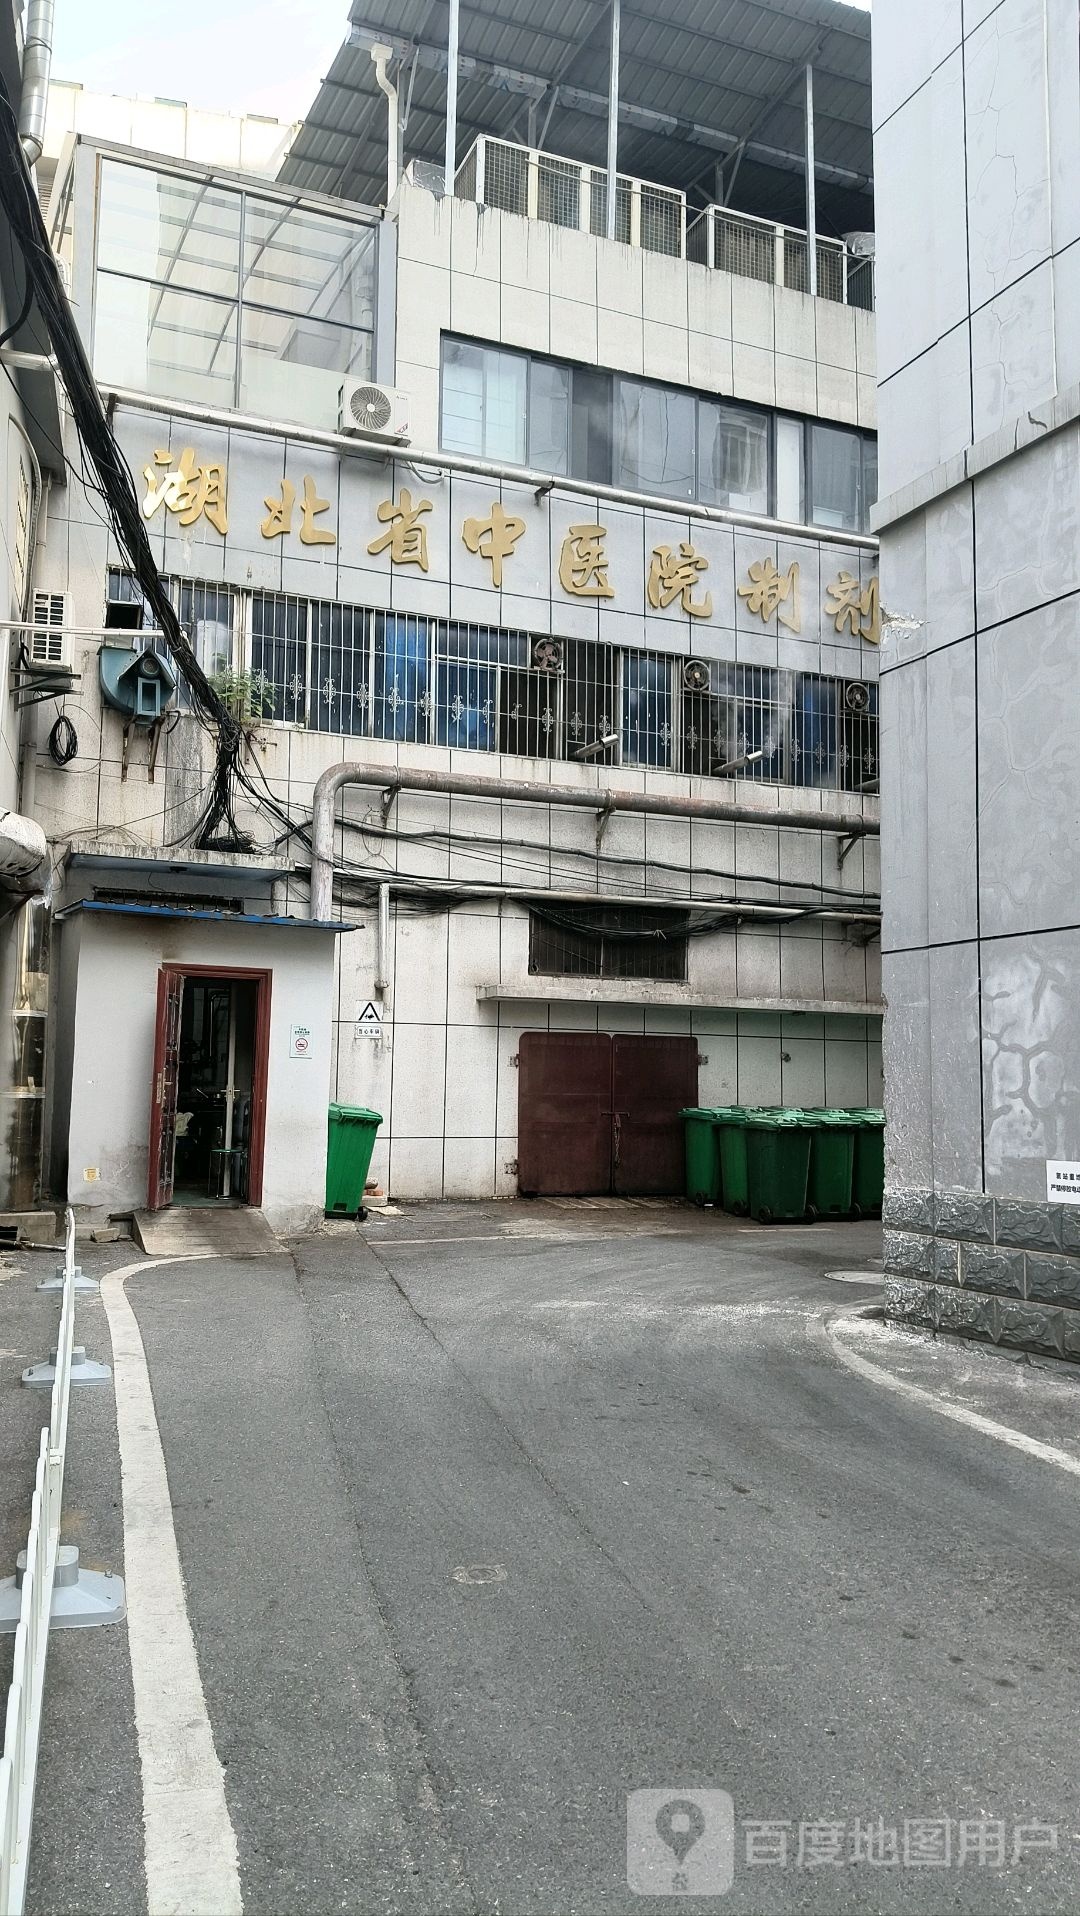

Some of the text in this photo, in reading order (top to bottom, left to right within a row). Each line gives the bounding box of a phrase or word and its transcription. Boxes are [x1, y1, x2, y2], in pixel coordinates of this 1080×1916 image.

[142, 447, 880, 645] 湖北省中医院制剂
